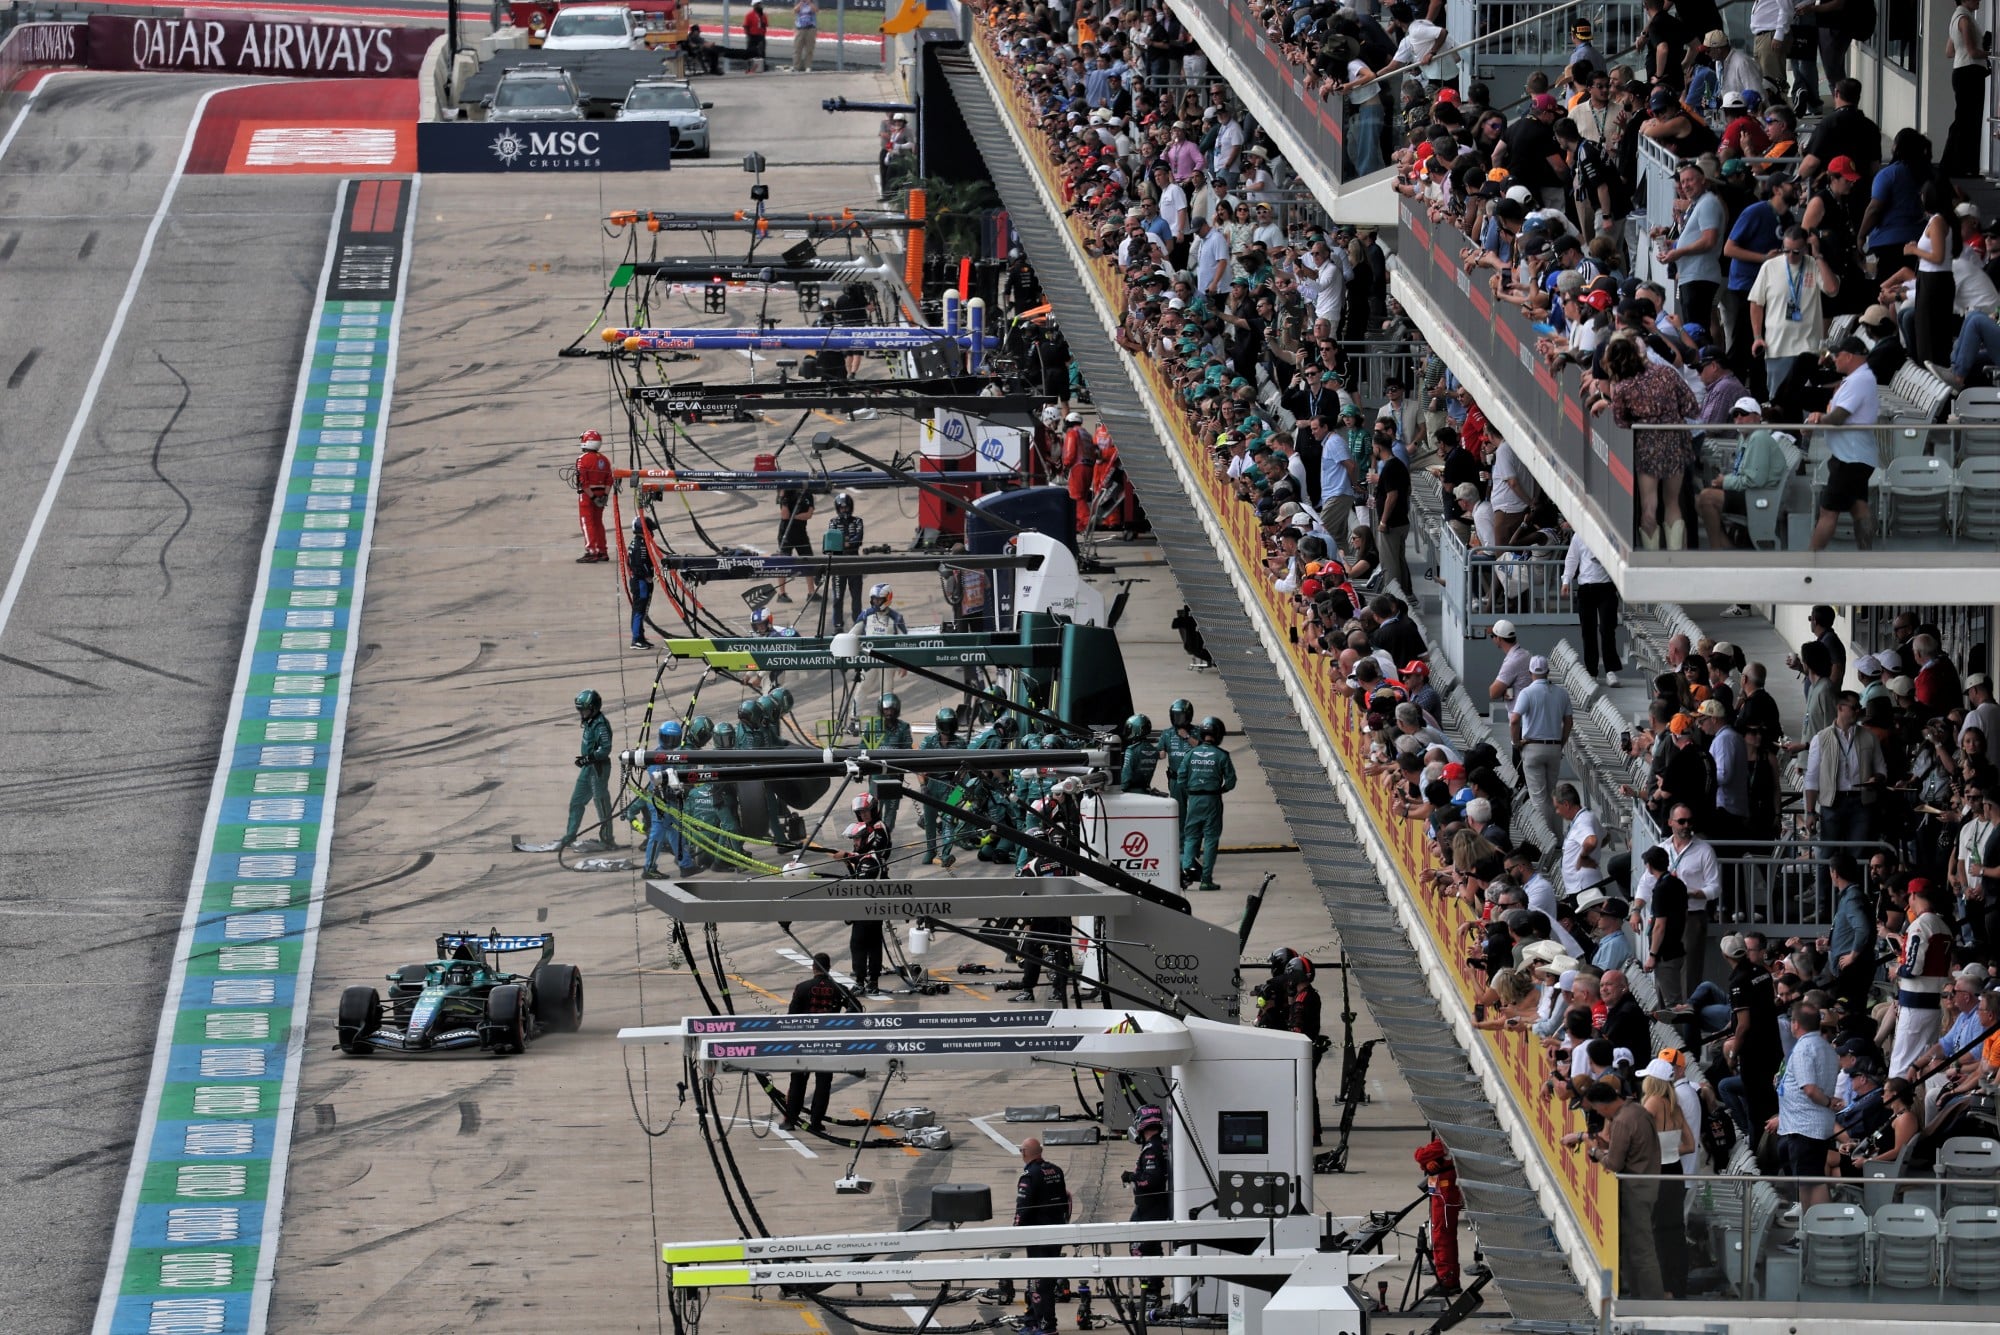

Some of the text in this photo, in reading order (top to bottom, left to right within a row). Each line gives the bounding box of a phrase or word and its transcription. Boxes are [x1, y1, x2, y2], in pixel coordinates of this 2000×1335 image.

[133, 19, 393, 73] QATAR AIRWAYS
[529, 131, 600, 156] MSC
[529, 159, 600, 168] CRUISES
[647, 469, 669, 477] Gulf
[727, 644, 759, 652] ASTON
[760, 643, 797, 652] MARTIN
[918, 639, 944, 648] arm
[766, 657, 798, 666] ASTON
[800, 656, 836, 665] MARTIN
[960, 652, 986, 662] arm
[1112, 858, 1159, 870] TGR
[1155, 973, 1199, 984] Revolut
[874, 1017, 903, 1027] MSC
[897, 1041, 926, 1051] MSC
[768, 1242, 832, 1252] CADILLAC
[777, 1270, 842, 1278] CADILLAC
